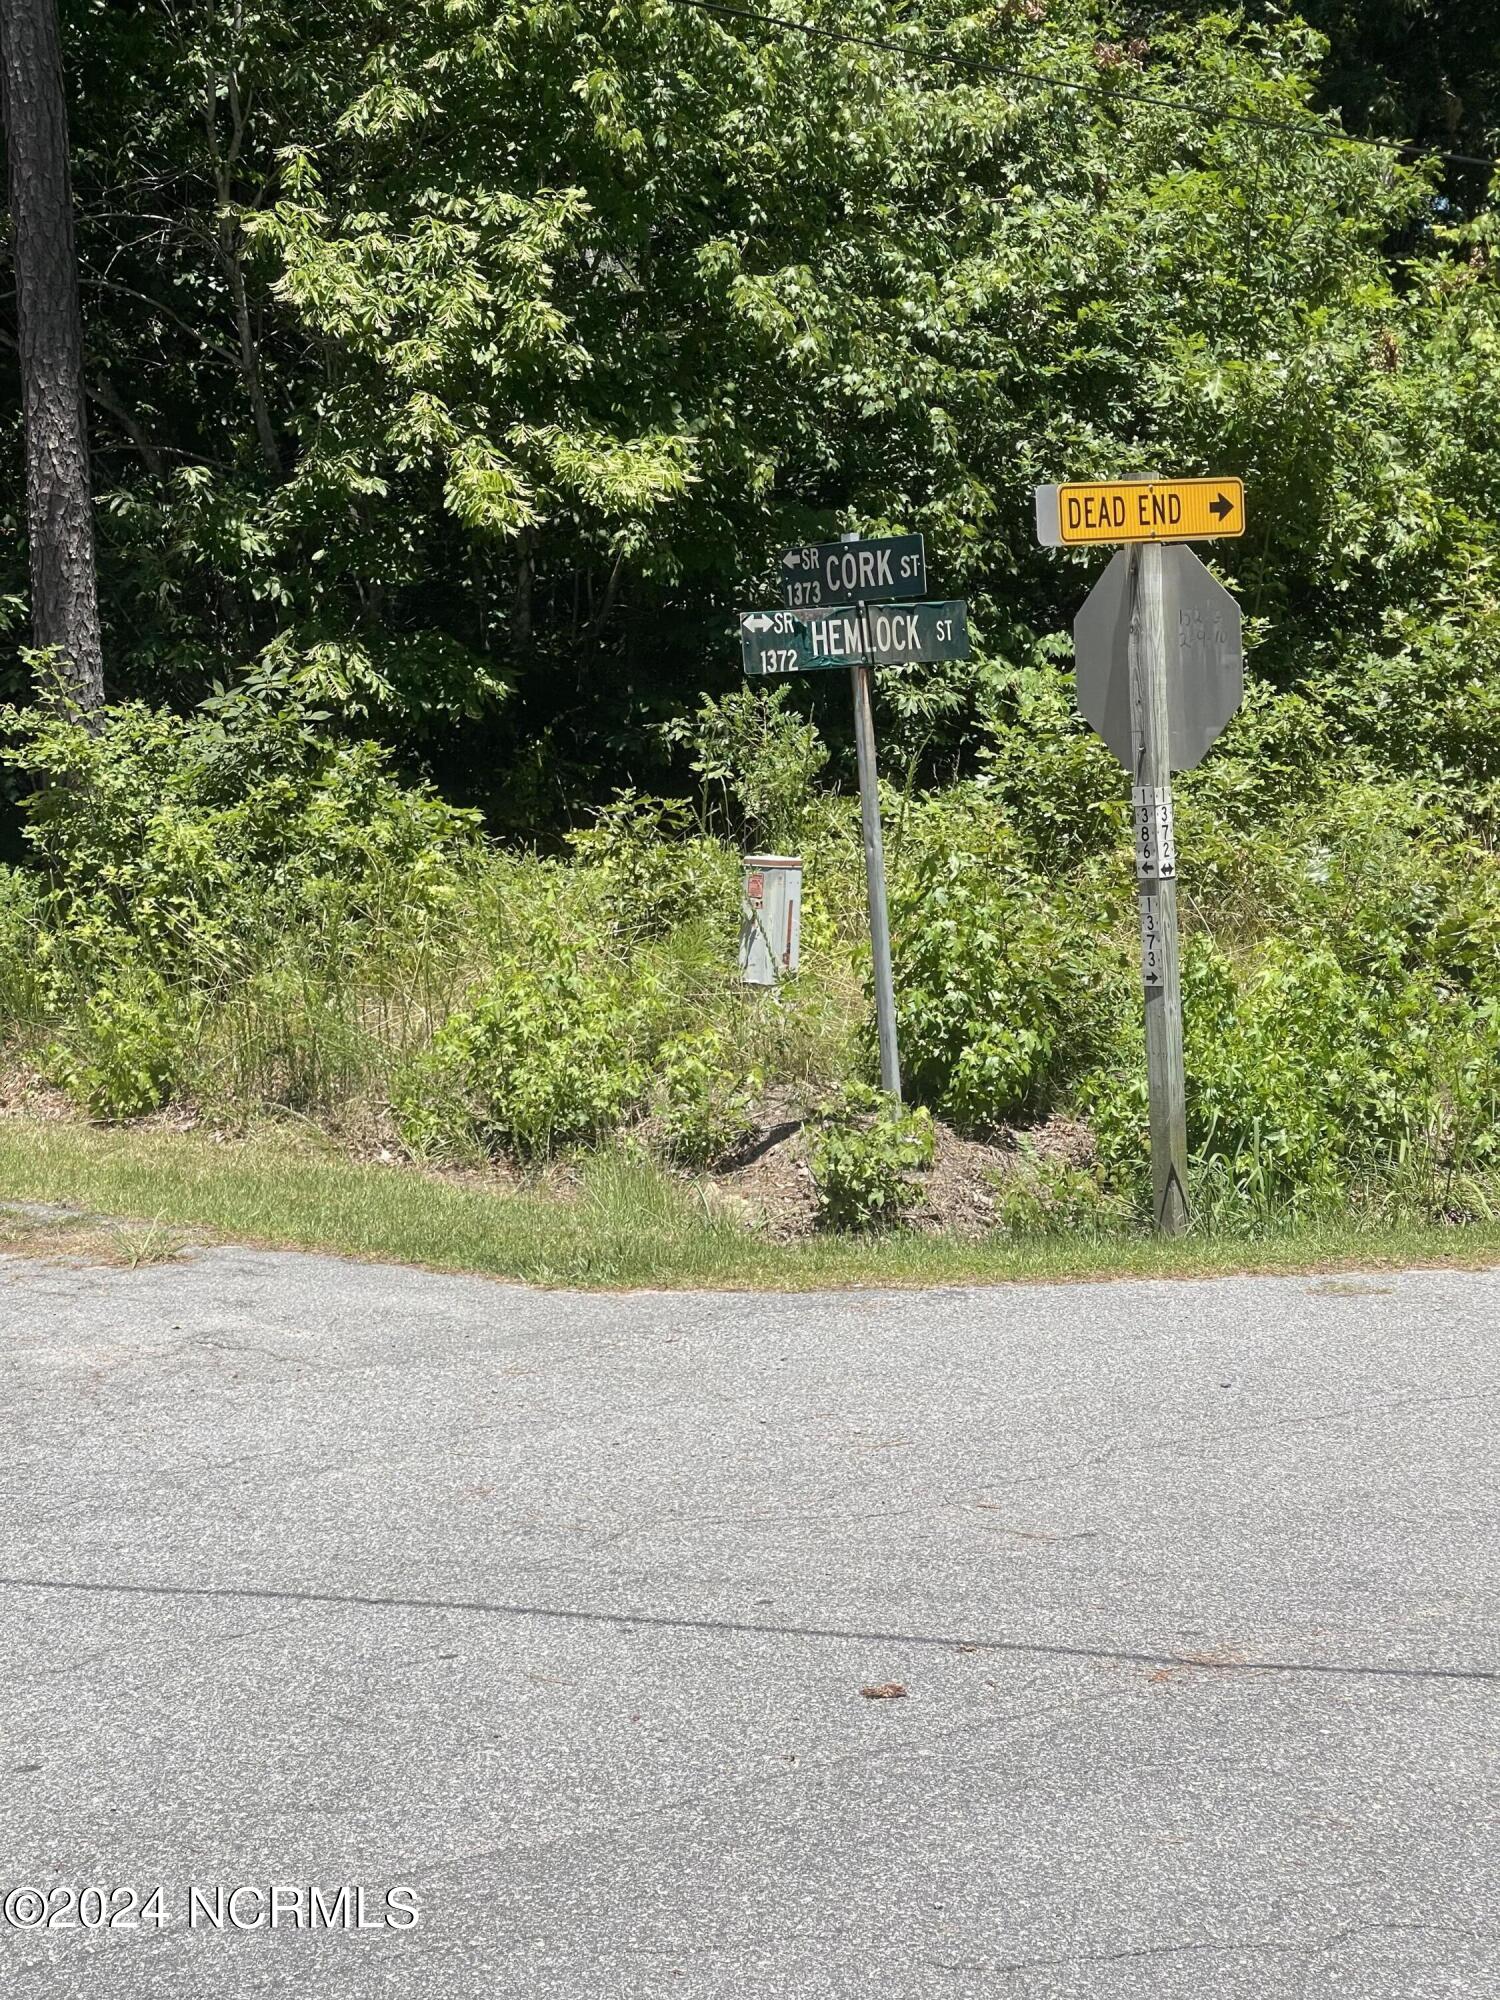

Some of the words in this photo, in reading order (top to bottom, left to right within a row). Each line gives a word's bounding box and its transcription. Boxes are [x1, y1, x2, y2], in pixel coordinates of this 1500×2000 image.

[1068, 496, 1125, 529] DEAD
[1138, 493, 1181, 526] END
[801, 548, 820, 570] SR
[826, 549, 894, 591] CORK
[900, 554, 920, 578] ST
[786, 580, 822, 606] 1373
[773, 612, 795, 634] SR
[811, 614, 921, 656] HEMLOCK
[936, 619, 953, 641] ST
[760, 649, 799, 673] 1372
[1141, 788, 1151, 859] 1386
[1161, 787, 1170, 858] 1372
[1146, 897, 1156, 967] 1373
